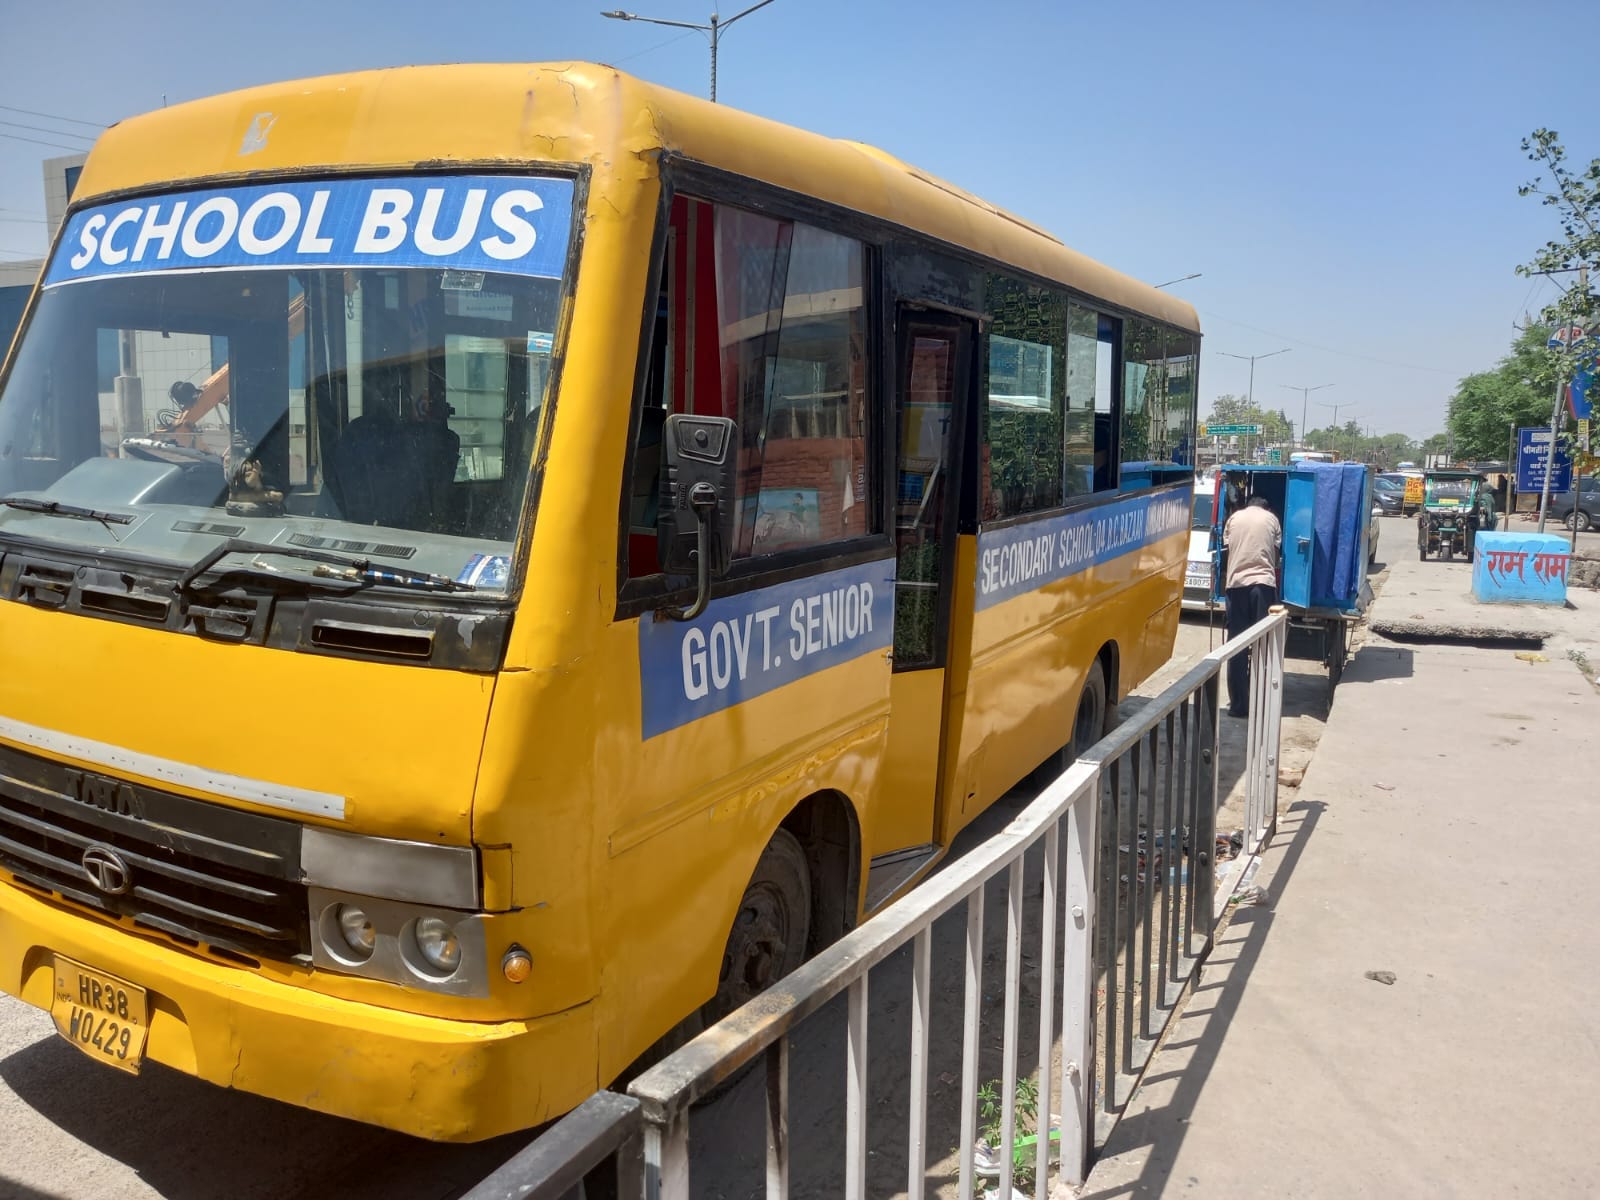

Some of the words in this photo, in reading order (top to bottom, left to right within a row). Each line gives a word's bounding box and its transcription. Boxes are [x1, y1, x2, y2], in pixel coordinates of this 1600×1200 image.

[70, 190, 335, 270] SCHOOL
[353, 188, 544, 261] BUS
[1487, 551, 1529, 589] राम
[1534, 553, 1569, 588] राम
[682, 605, 781, 701] GOVT.
[790, 582, 874, 661] SENIOR
[980, 533, 1056, 595] SECONDARY
[64, 767, 145, 821] TATA
[79, 972, 129, 1021] HR38
[69, 1006, 131, 1060] W0429
